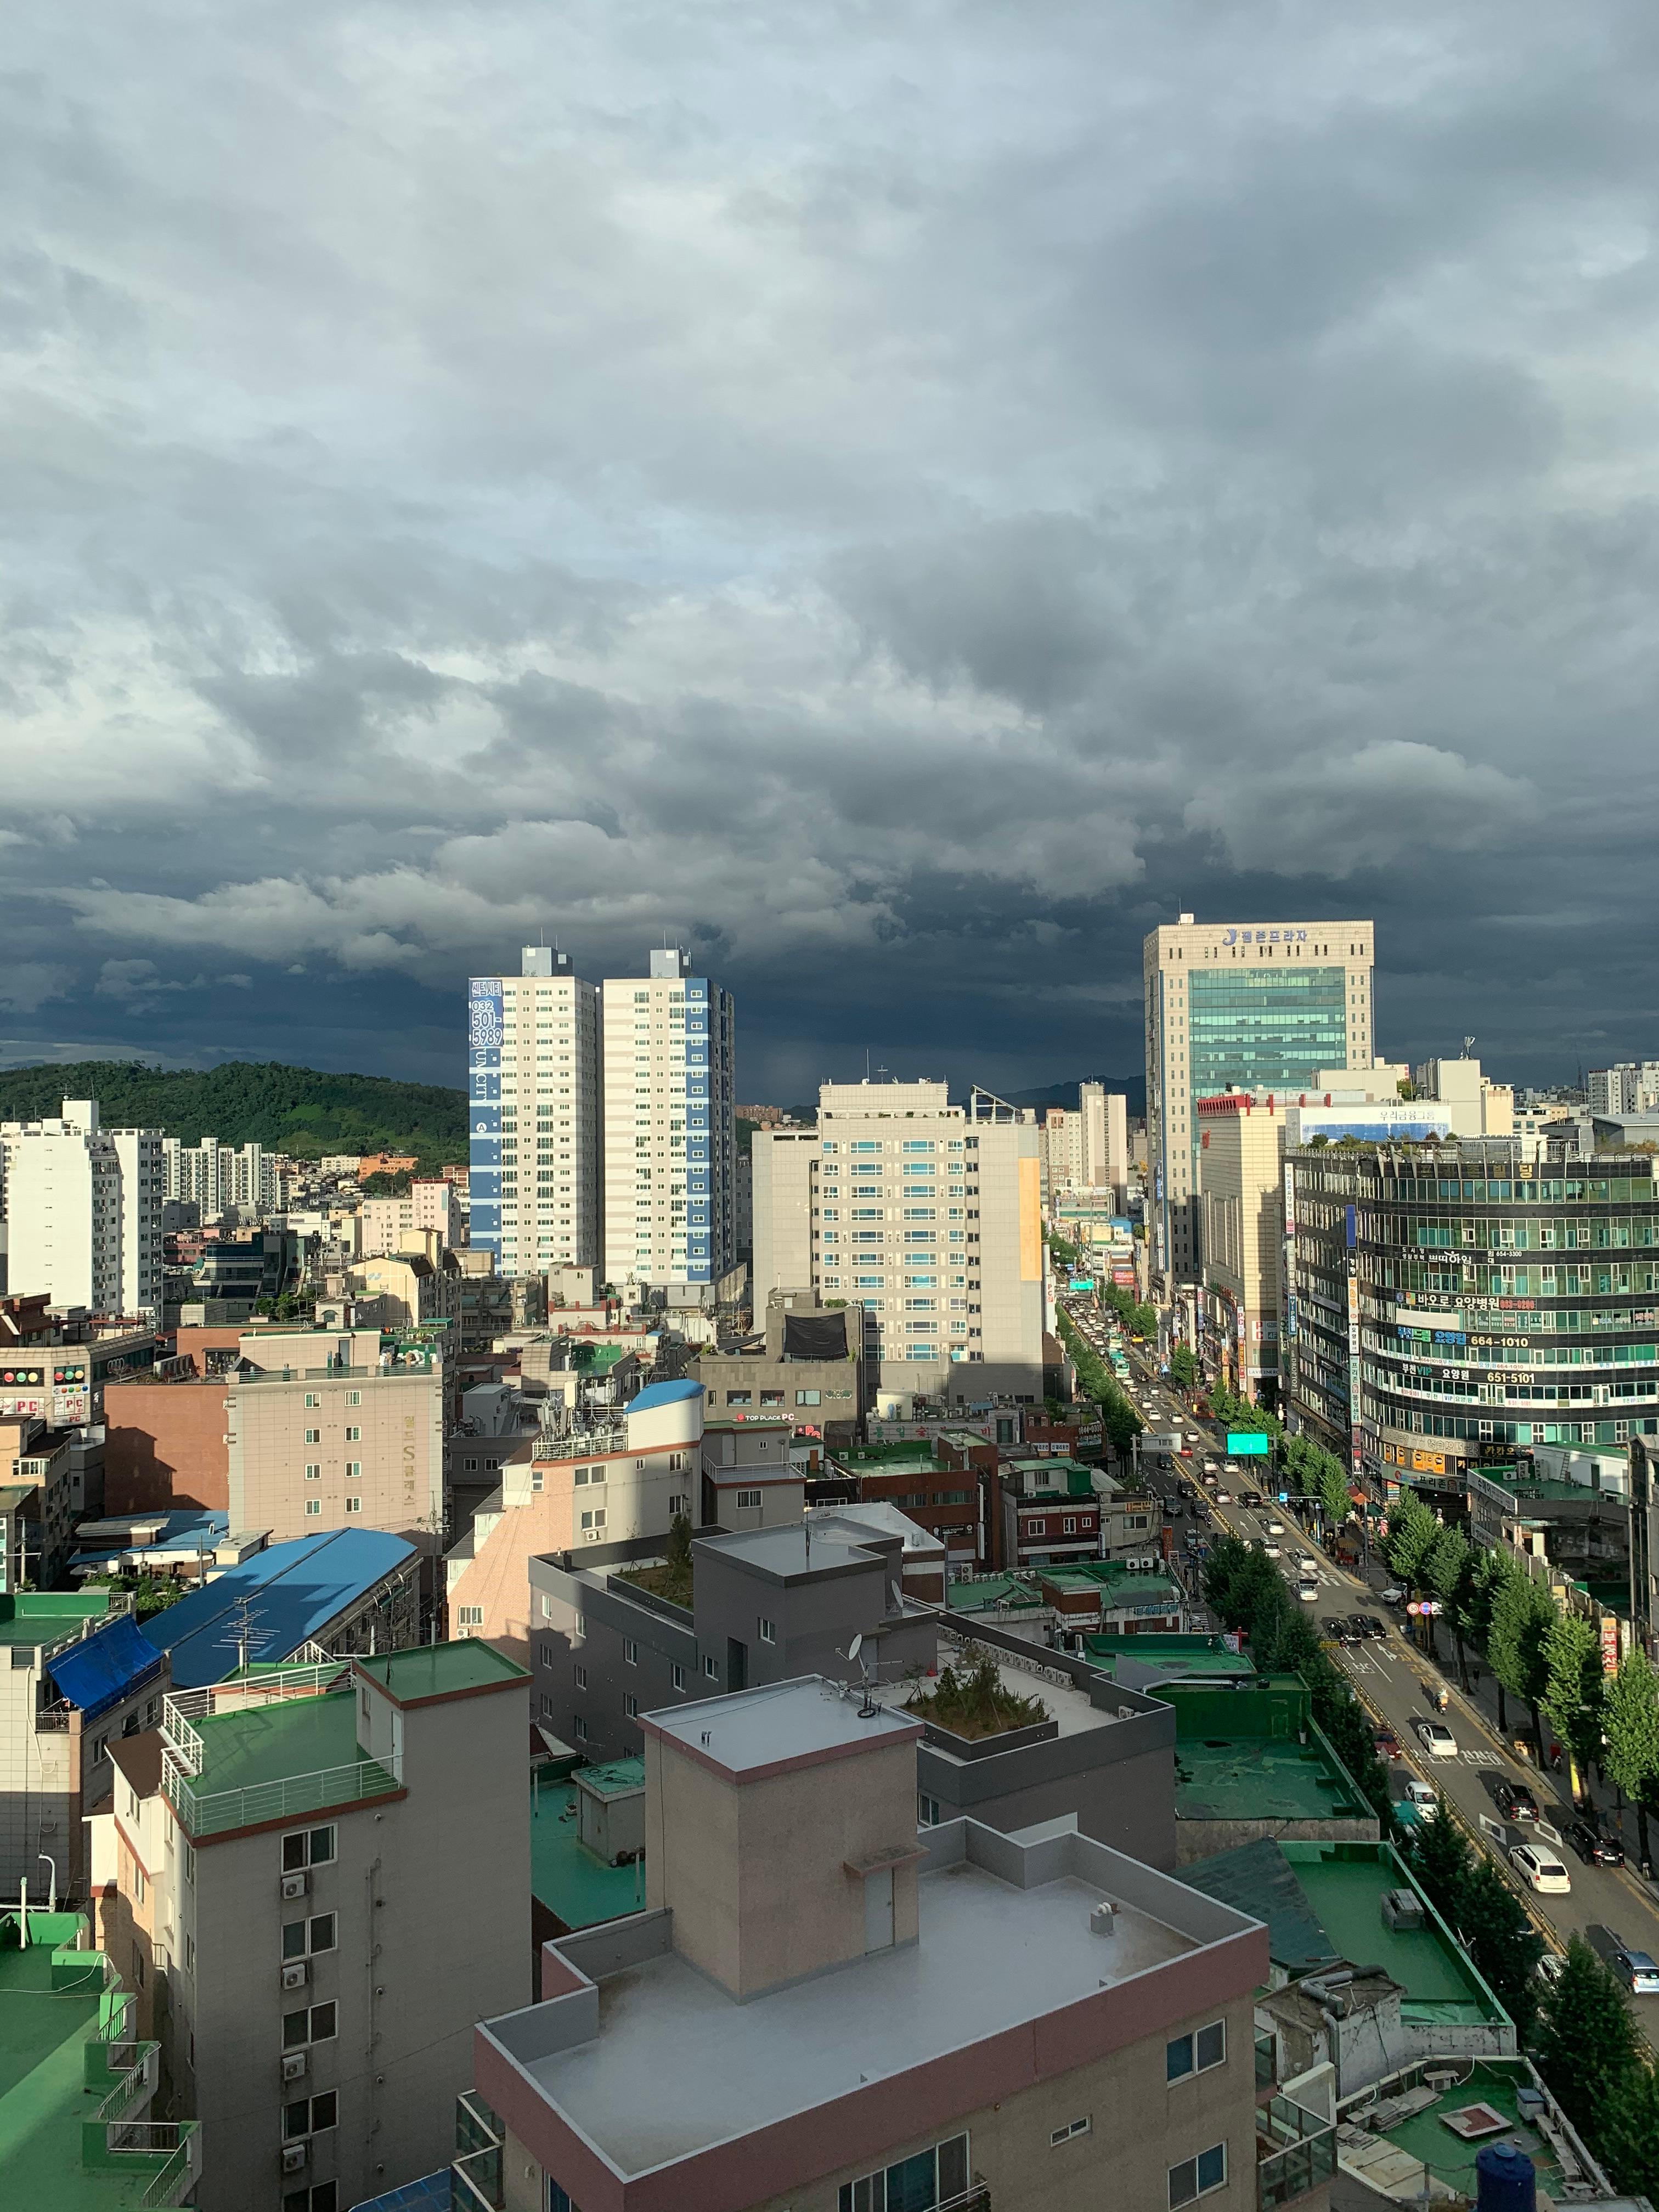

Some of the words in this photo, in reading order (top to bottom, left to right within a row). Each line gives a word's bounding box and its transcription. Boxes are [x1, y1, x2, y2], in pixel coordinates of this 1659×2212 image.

[472, 981, 502, 997] 센텀시티
[472, 1000, 494, 1011] 032
[472, 1012, 502, 1028] 501-
[472, 1028, 503, 1046] 5989
[1380, 1110, 1435, 1121] 우리금융그룹
[1418, 1294, 1451, 1307] 바오로
[1454, 1297, 1499, 1311] 요양병원
[1256, 1322, 1263, 1340] PC
[1397, 1327, 1431, 1342] 부천드림
[1435, 1331, 1466, 1345] 요양원
[1471, 1336, 1528, 1347] 664-1010
[1442, 1369, 1470, 1380] 요양원
[1487, 1372, 1534, 1384] 651-5101
[17, 1401, 37, 1412] PC
[66, 1400, 83, 1408] PC
[1486, 1446, 1515, 1456] 카카오
[1460, 1749, 1505, 1766] 천천히
